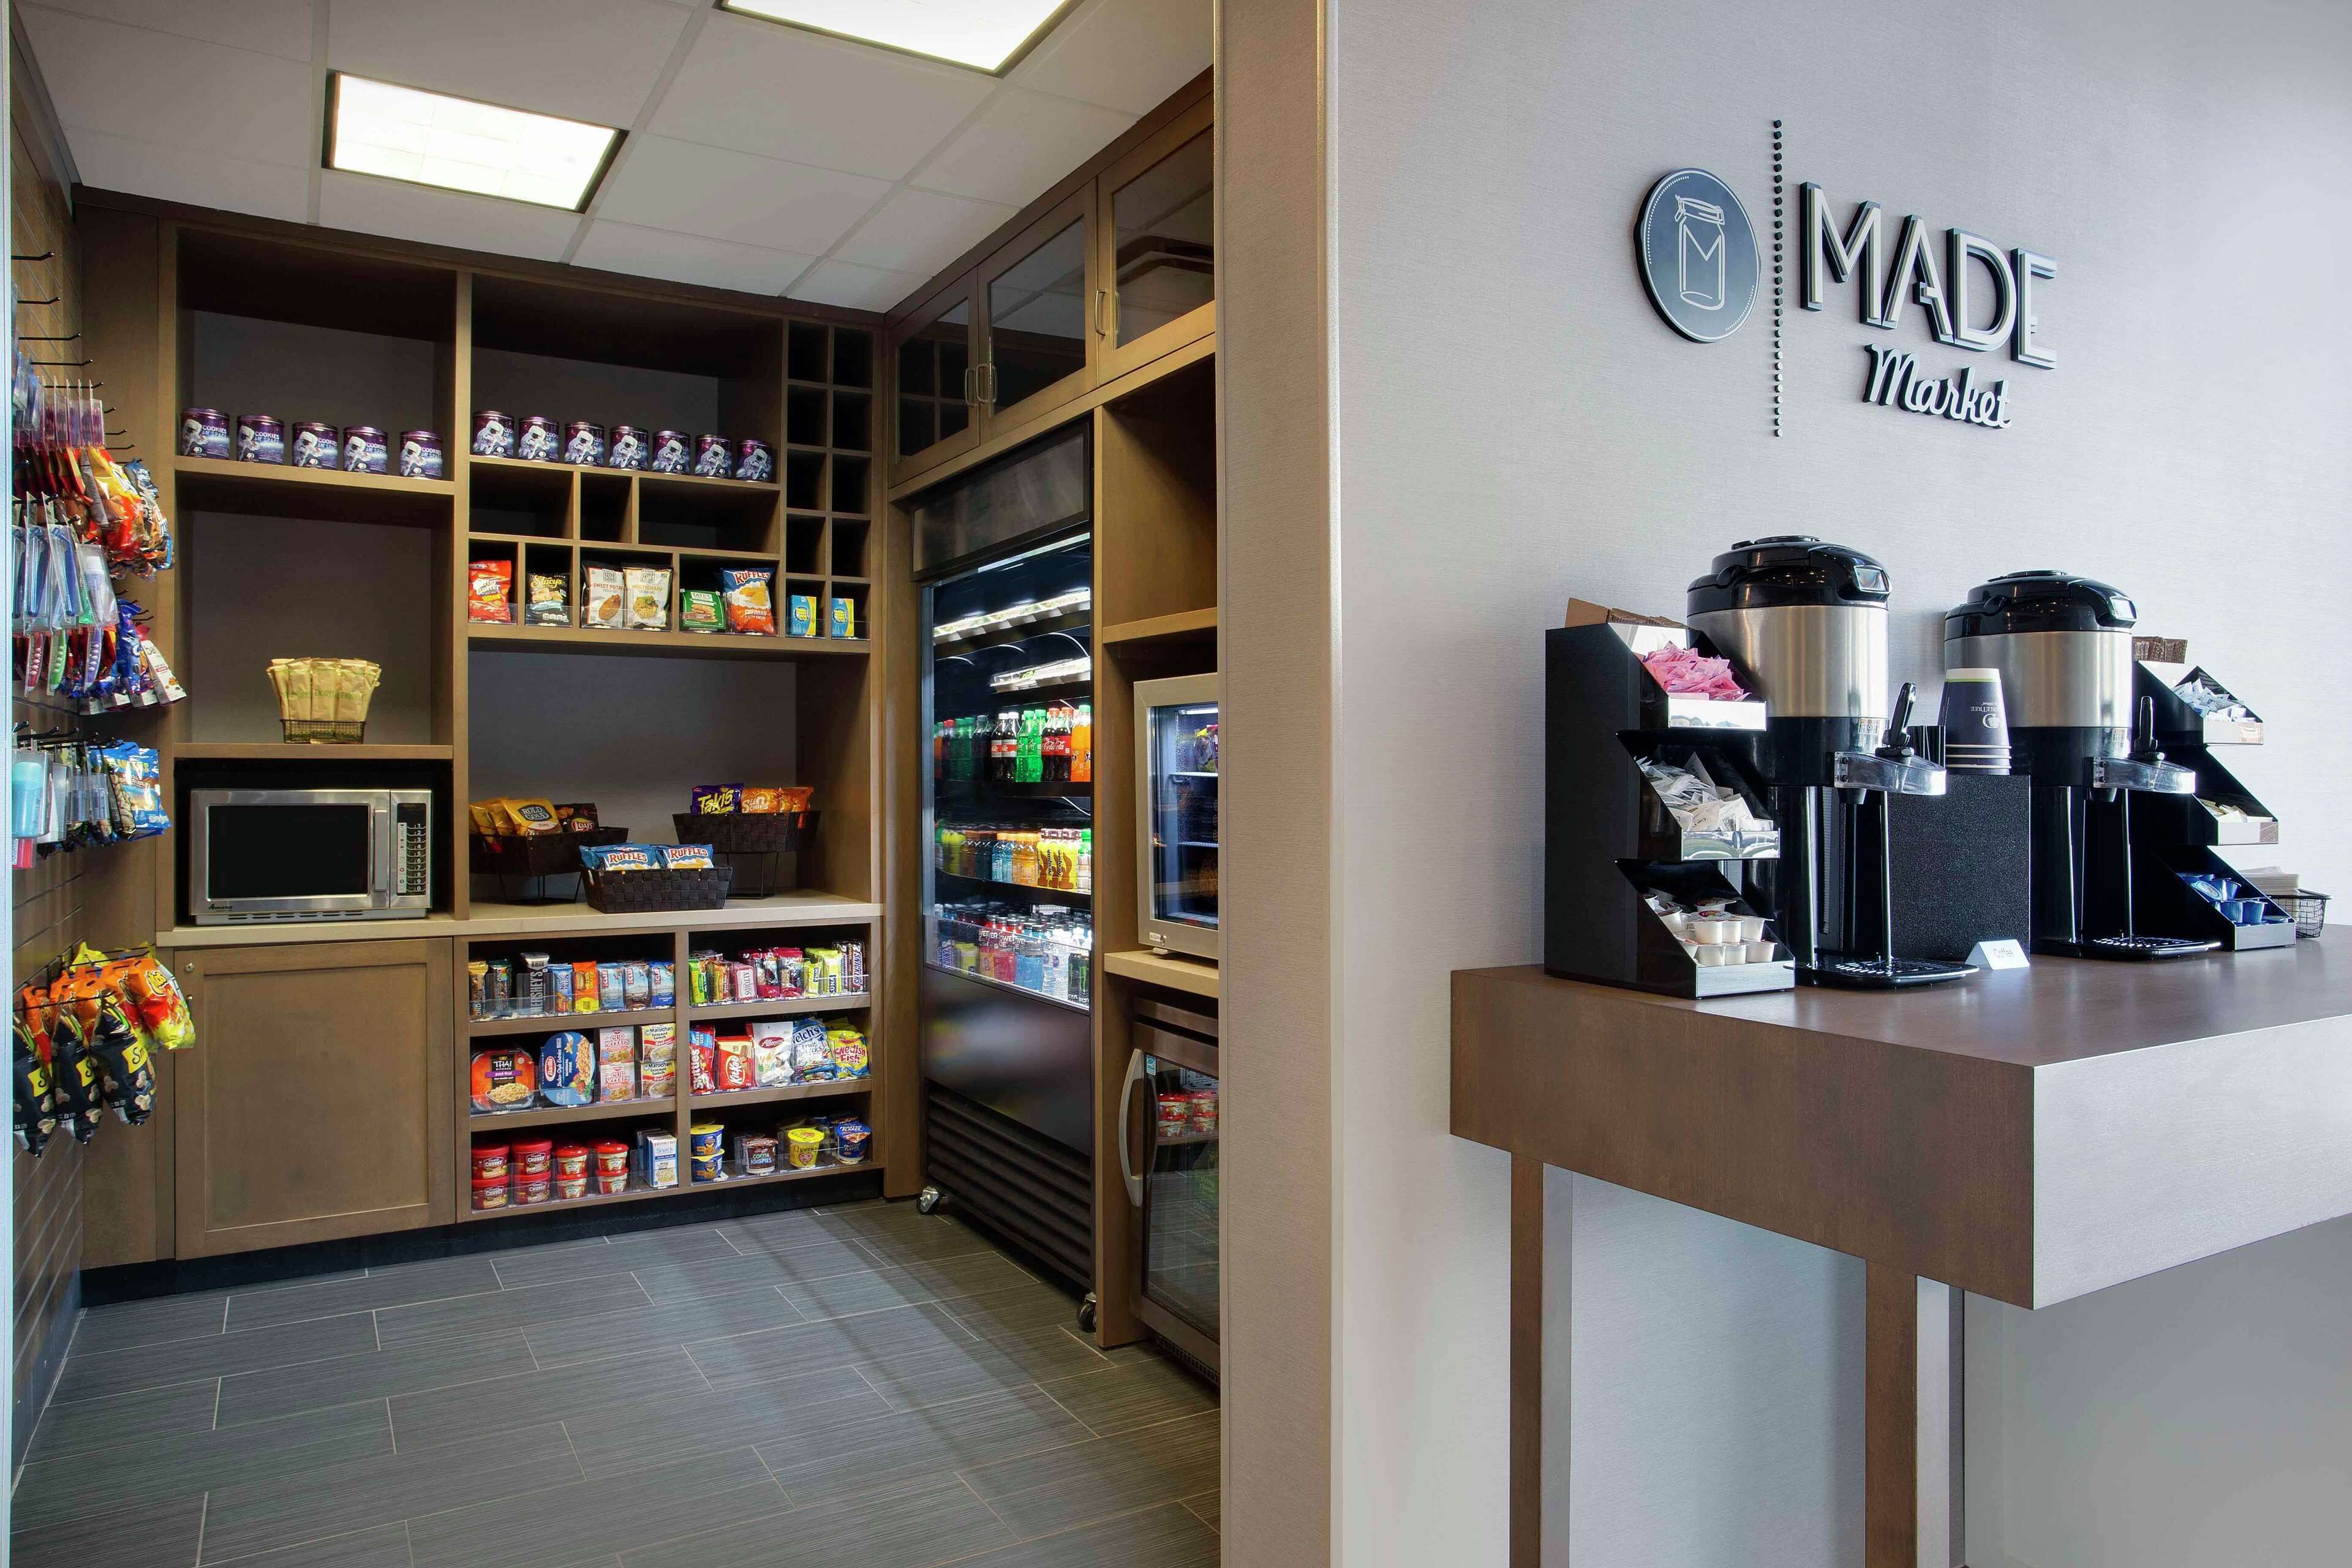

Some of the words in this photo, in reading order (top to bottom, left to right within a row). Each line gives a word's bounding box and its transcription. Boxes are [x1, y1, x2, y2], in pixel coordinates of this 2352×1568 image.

[1799, 181, 2057, 370] MADE
[1863, 344, 2011, 429] Market
[202, 425, 227, 434] COOKIES
[255, 431, 280, 440] COOKIES
[521, 806, 543, 815] ROLD
[524, 812, 549, 821] GOLD
[608, 852, 648, 863] RUFFLES
[669, 848, 708, 859] RUFFLES
[1993, 948, 2015, 959] Coffee
[853, 952, 863, 987] SNICKERS
[530, 970, 543, 1014] HERSHEY'S
[605, 1039, 630, 1047] NOODLES
[835, 1044, 866, 1057] Swedish
[840, 1054, 861, 1064] Fish
[691, 1049, 704, 1089] Skittles
